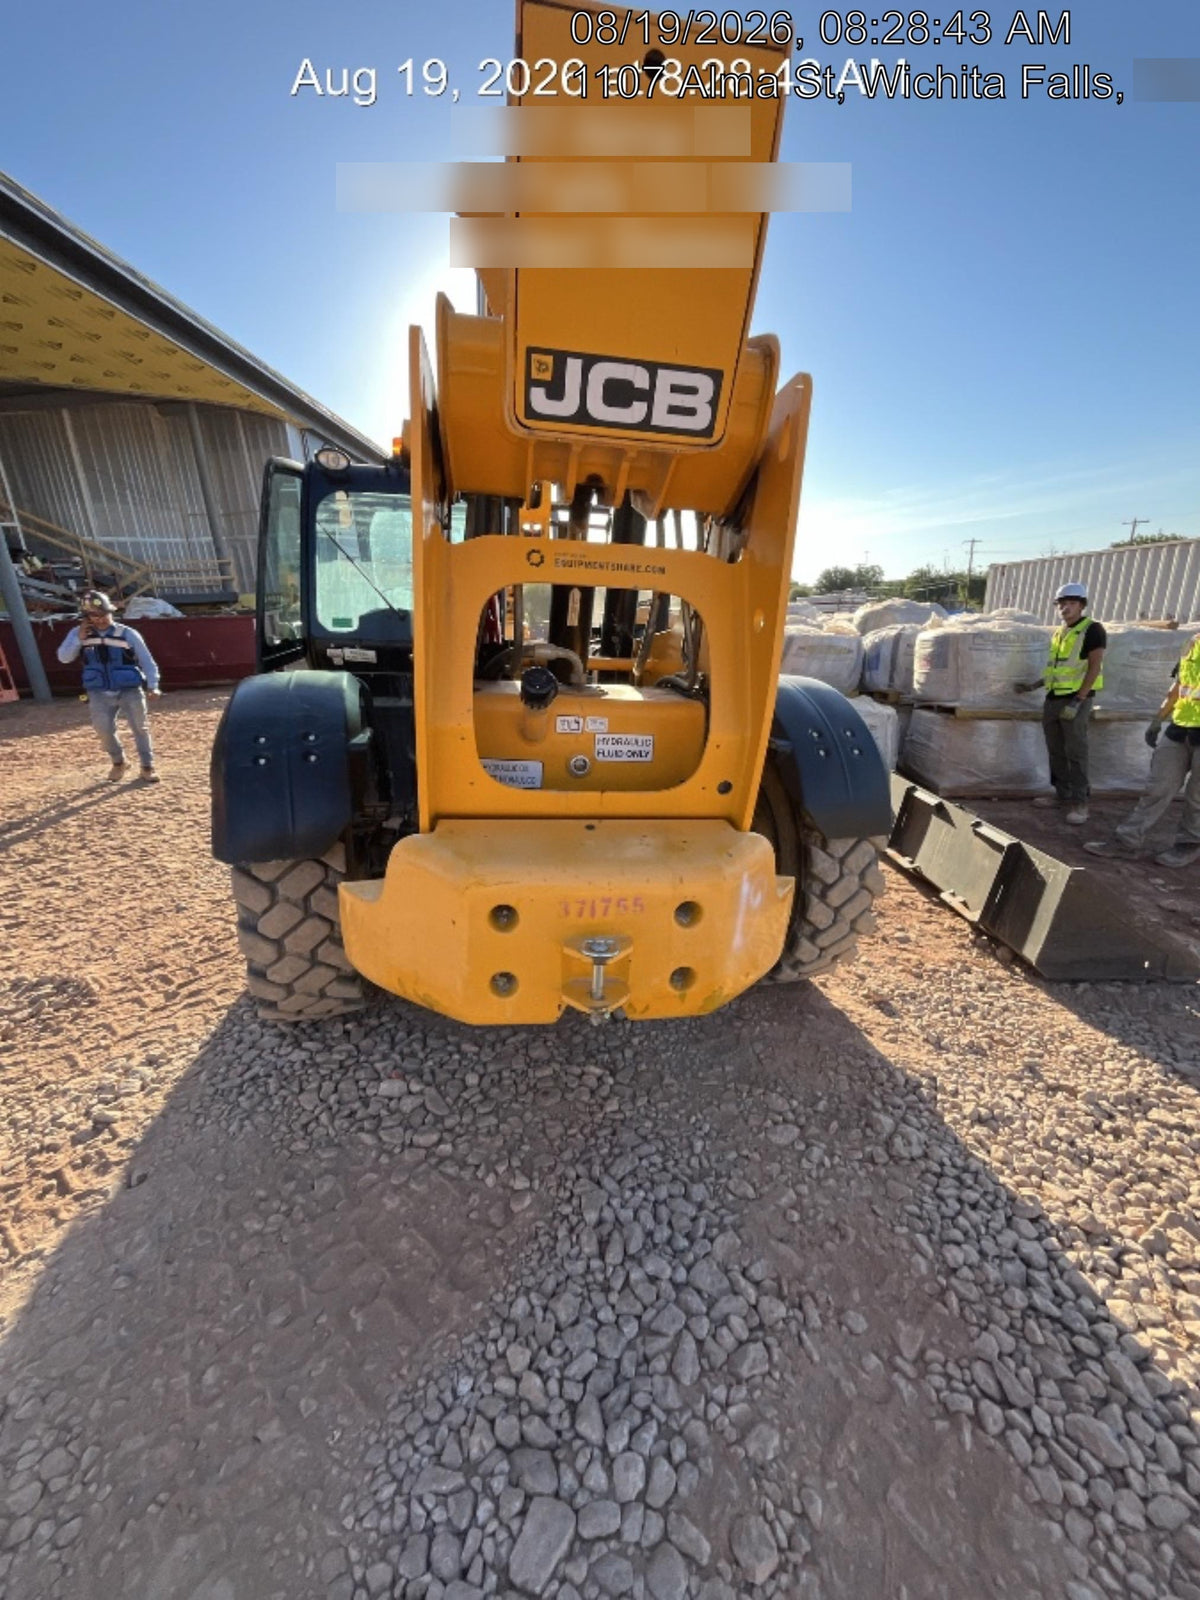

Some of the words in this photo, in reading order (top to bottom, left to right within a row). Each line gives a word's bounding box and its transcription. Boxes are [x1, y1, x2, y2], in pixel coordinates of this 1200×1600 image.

[529, 357, 715, 431] JCB
[596, 737, 652, 748] HYDRAULIC
[597, 749, 624, 758] FLUID
[626, 749, 650, 758] ONLY
